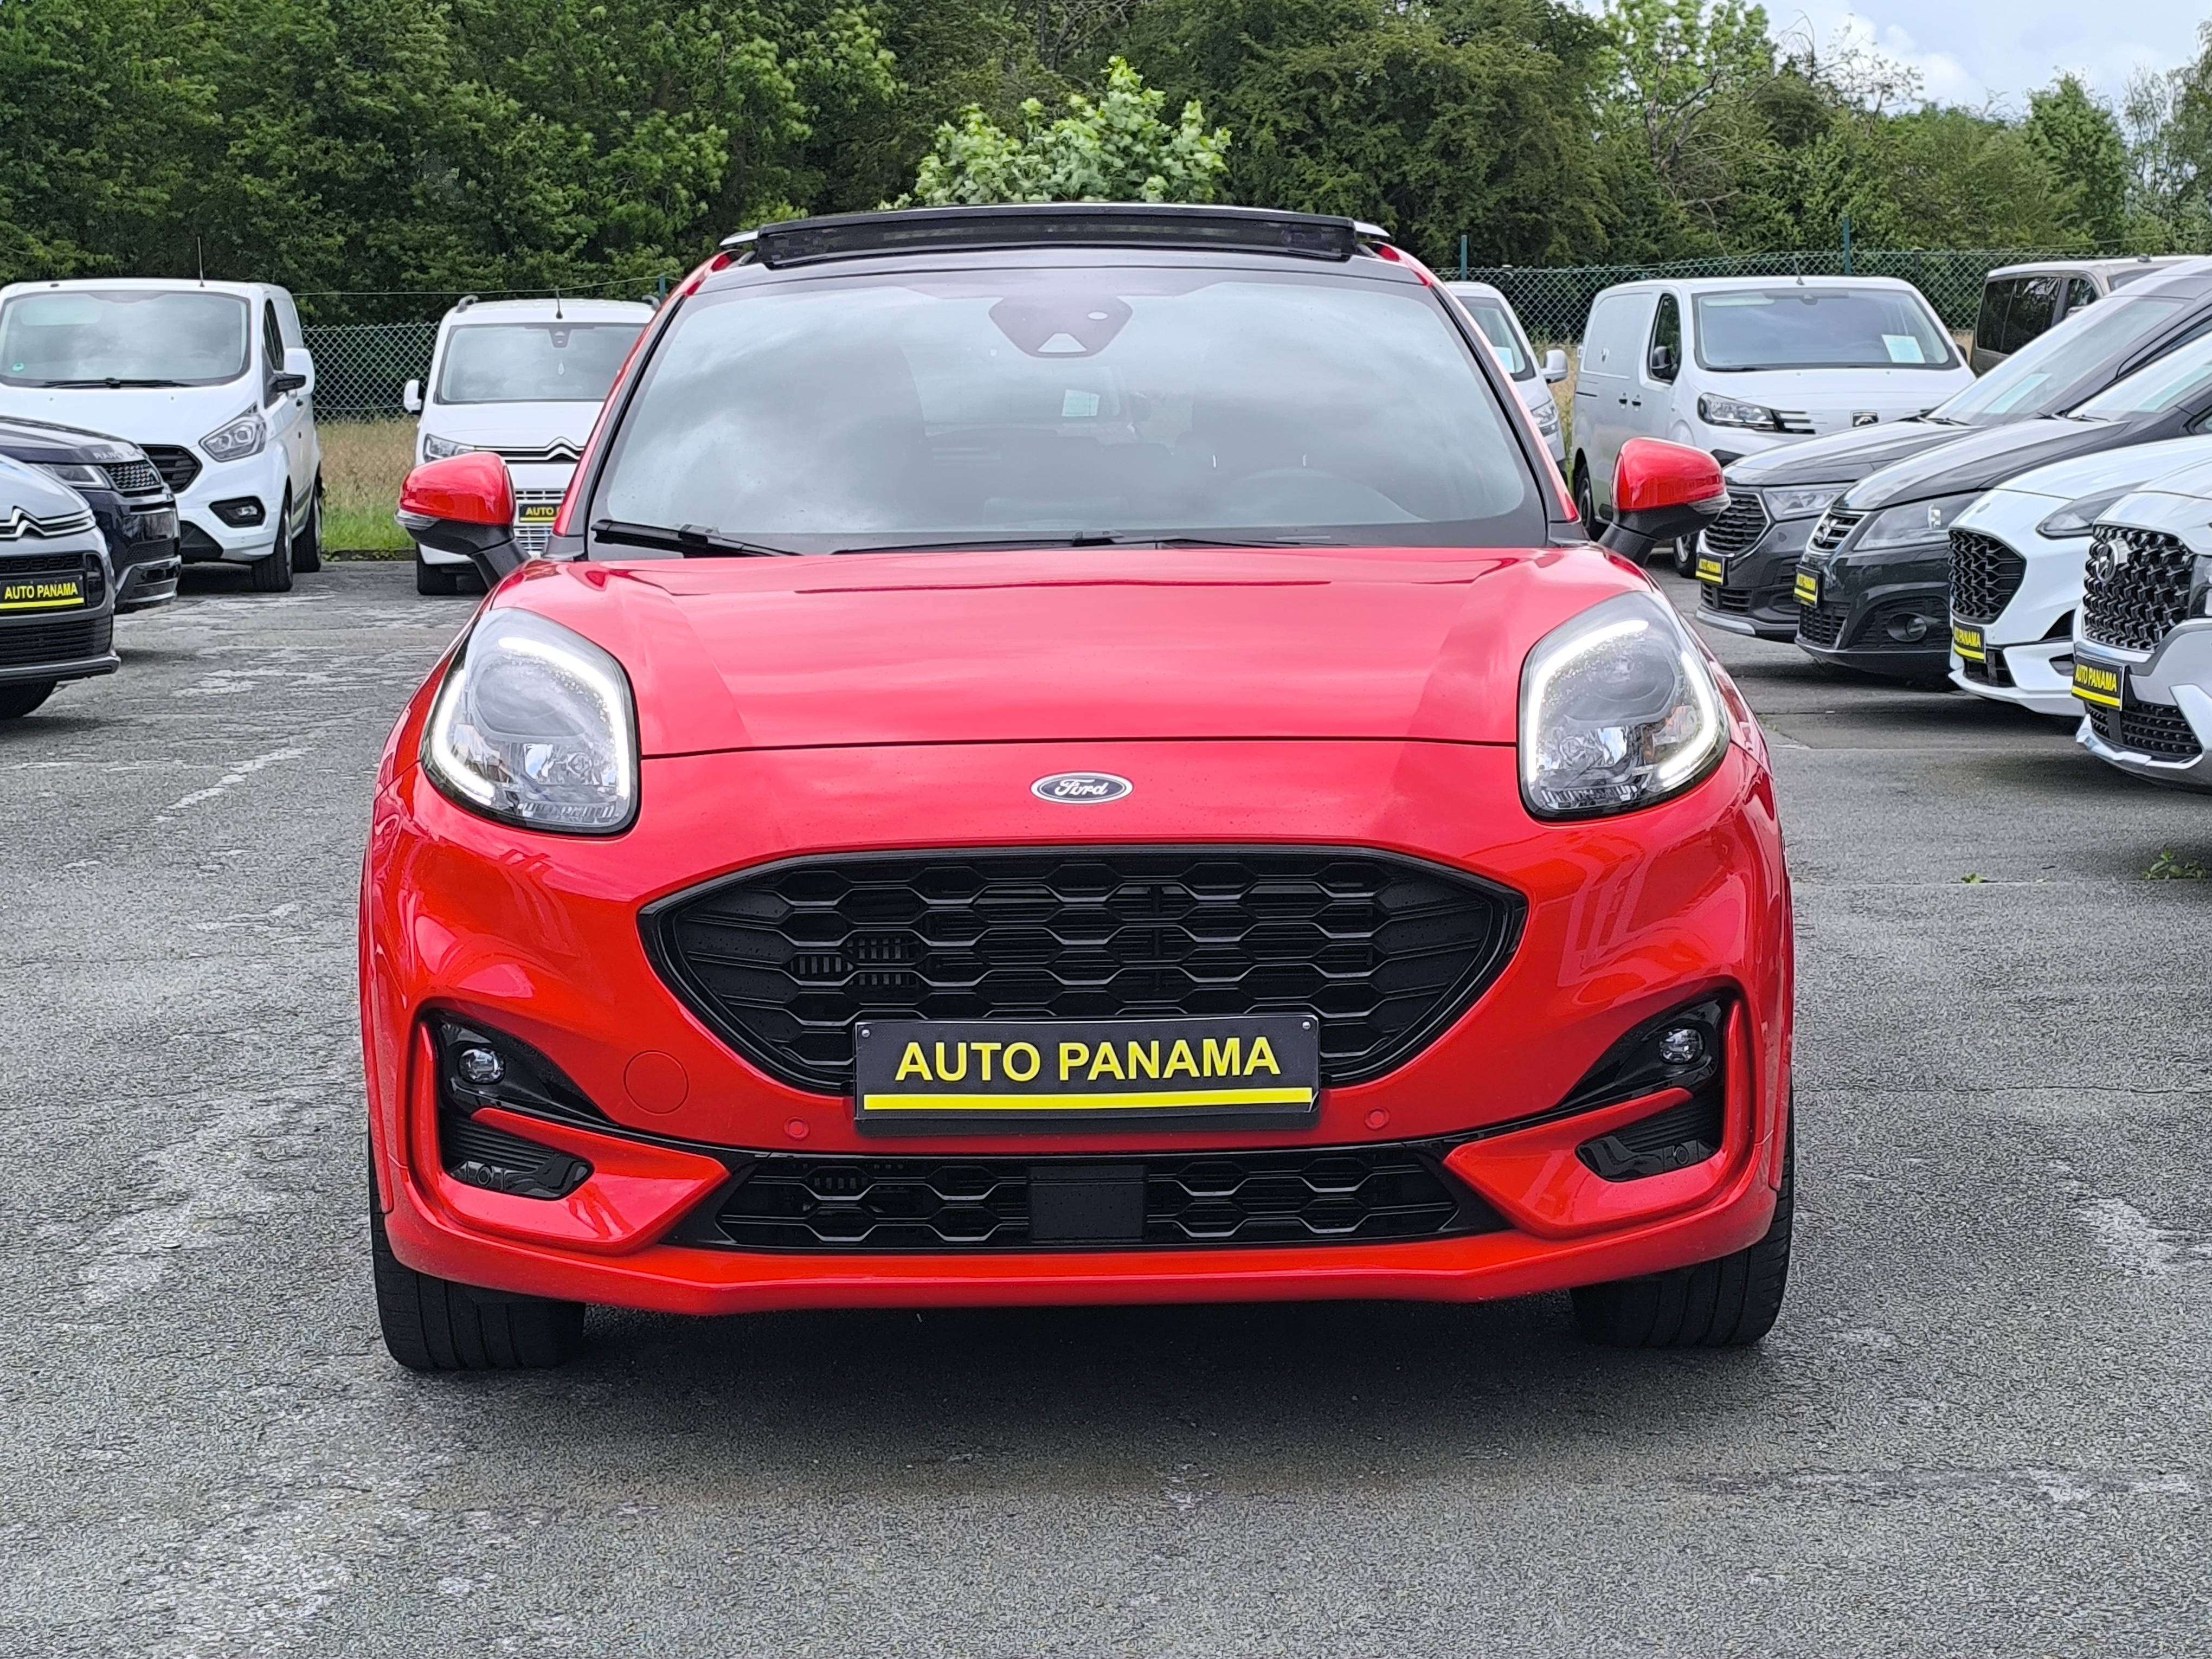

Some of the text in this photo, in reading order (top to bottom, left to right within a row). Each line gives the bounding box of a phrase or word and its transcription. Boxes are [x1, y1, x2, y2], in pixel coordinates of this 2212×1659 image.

[526, 507, 554, 516] AUTO
[4, 582, 78, 600] AUTO PANAMA
[2088, 667, 2117, 692] PANAMA
[1054, 779, 1109, 796] Ford
[895, 1037, 1282, 1081] AUTO PANAMA
